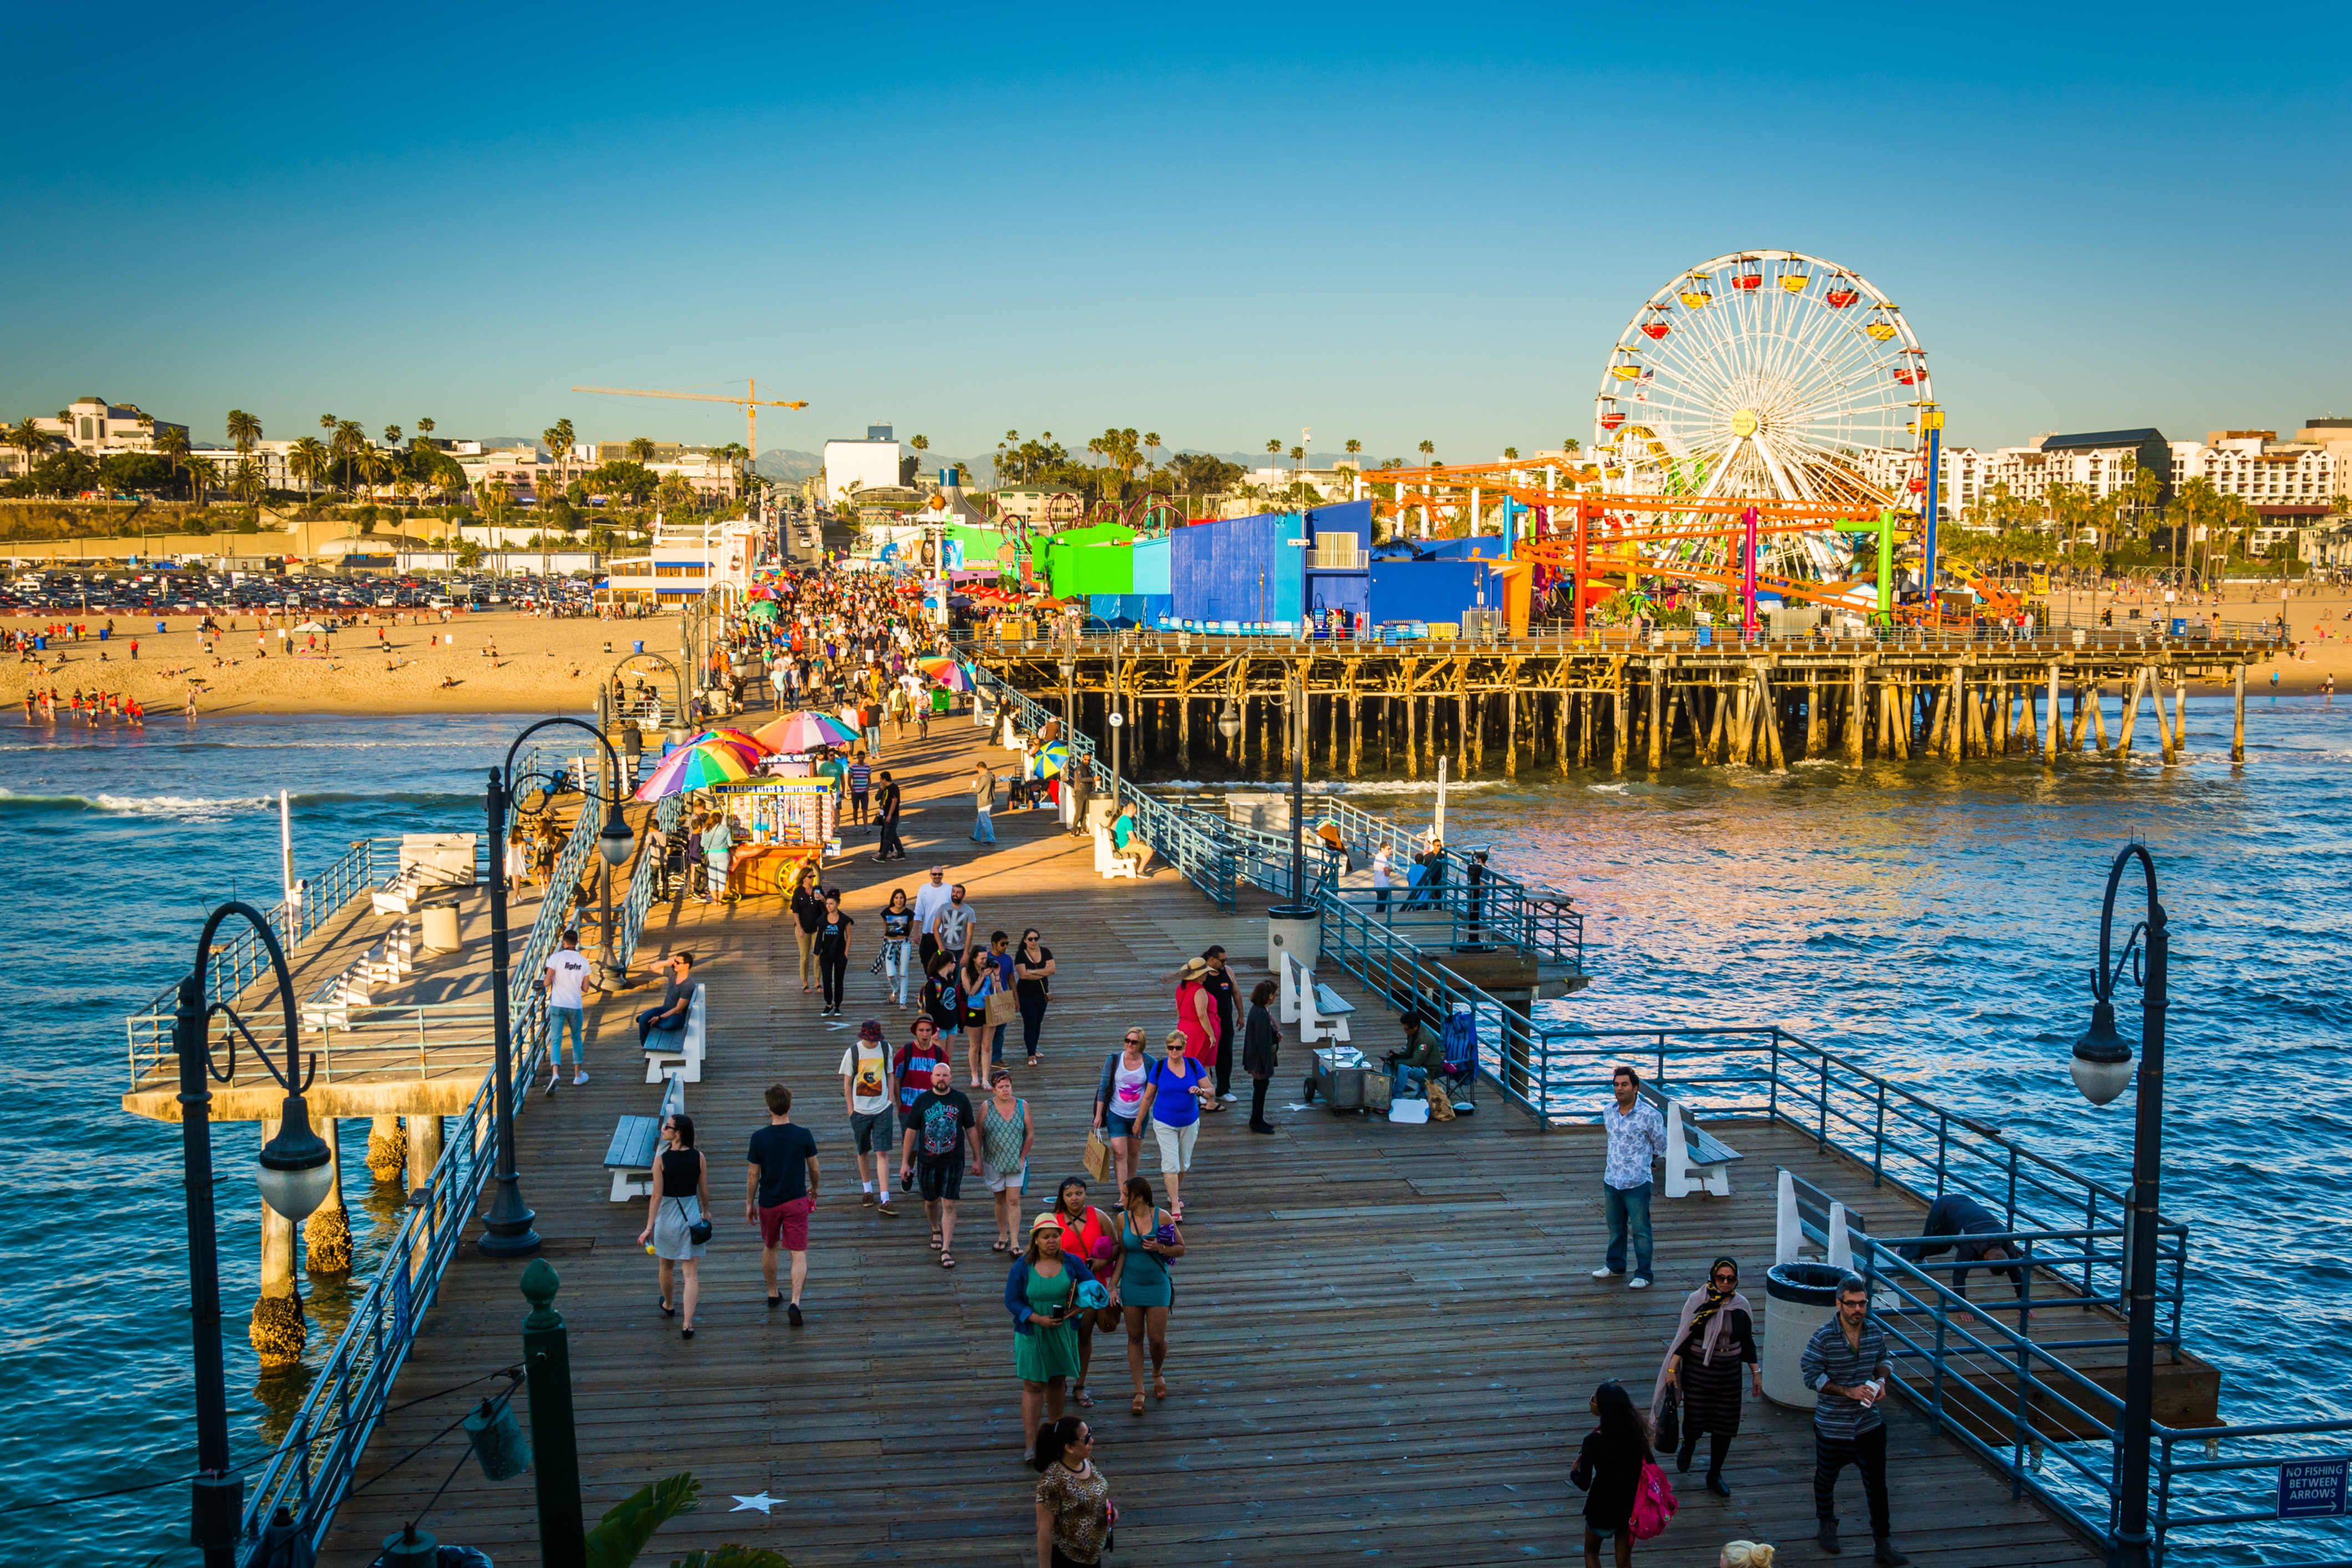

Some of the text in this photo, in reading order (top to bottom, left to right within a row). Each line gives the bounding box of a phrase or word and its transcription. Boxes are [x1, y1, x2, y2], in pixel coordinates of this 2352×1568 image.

[565, 961, 582, 970] light
[992, 1002, 1014, 1020] COTTON
[993, 1014, 1003, 1023] ON
[924, 1104, 959, 1115] RALLY
[925, 1142, 954, 1154] RIDERS
[1086, 1144, 1102, 1168] COTTON
[2286, 1465, 2343, 1478] NO FISHING
[2289, 1477, 2338, 1488] BETWEEN
[2289, 1488, 2336, 1500] ARROWS
